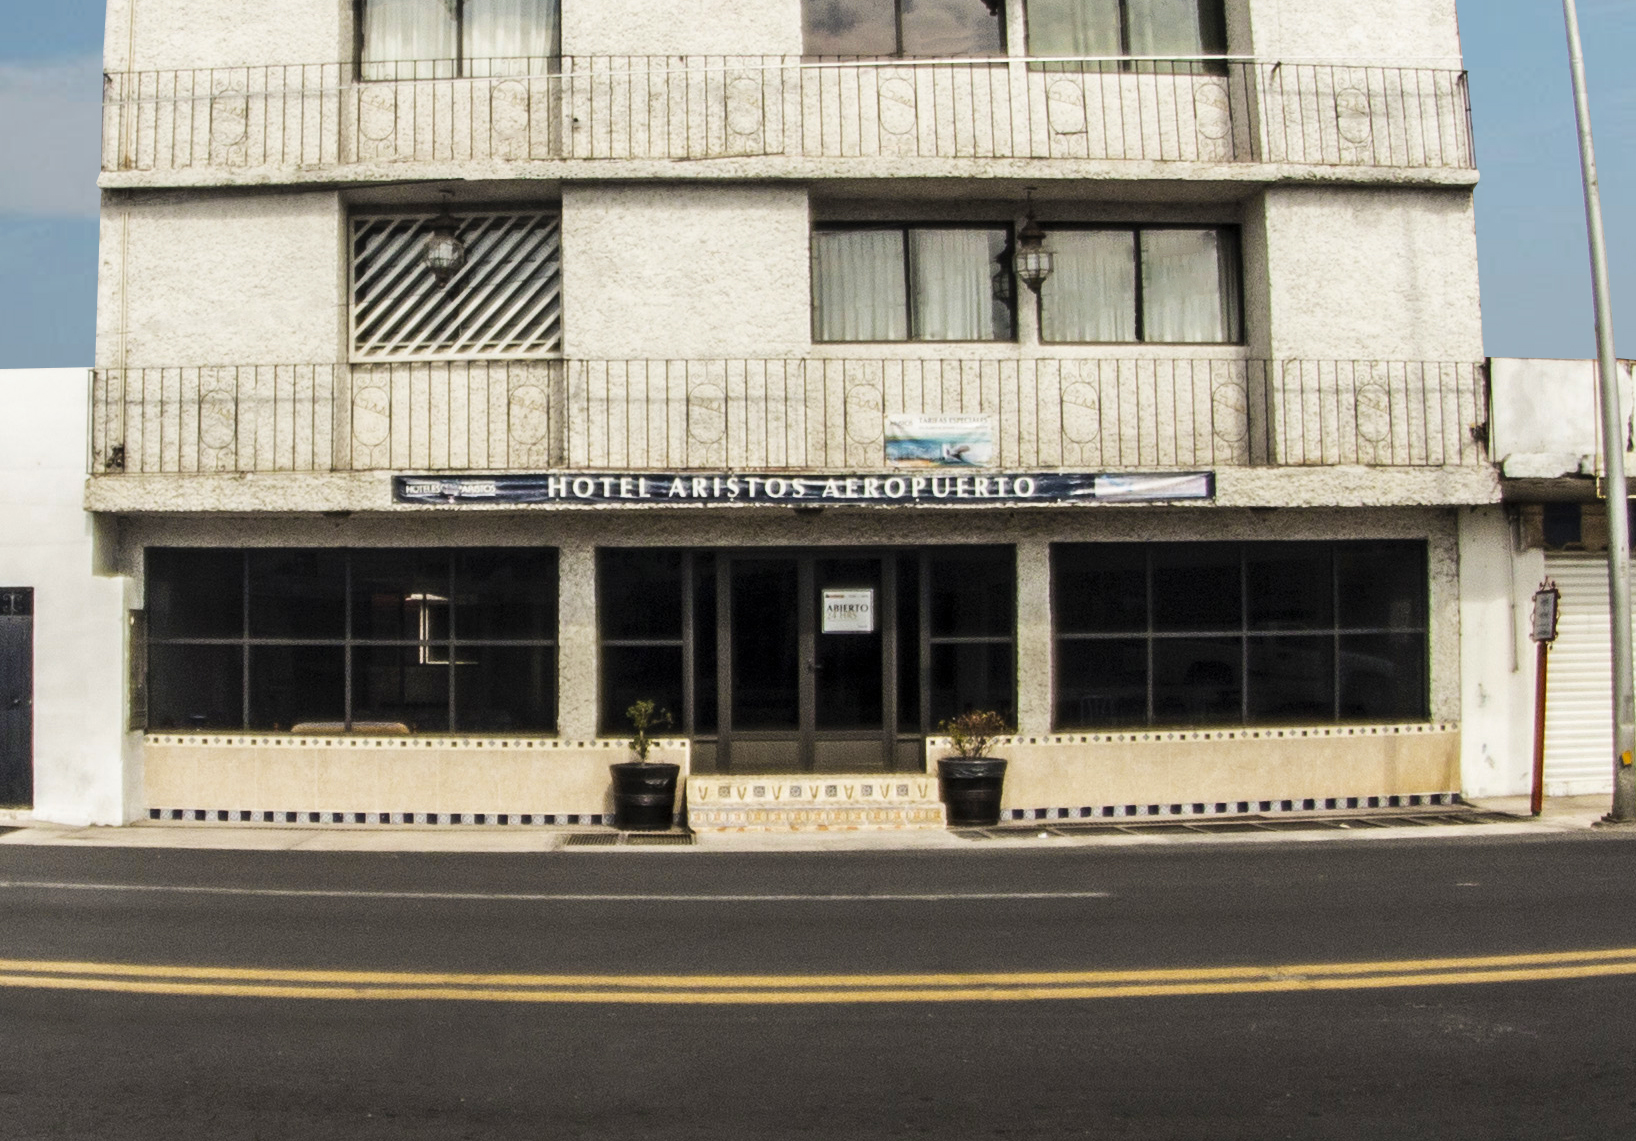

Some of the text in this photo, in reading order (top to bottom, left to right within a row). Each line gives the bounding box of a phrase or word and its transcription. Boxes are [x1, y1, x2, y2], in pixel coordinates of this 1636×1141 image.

[919, 416, 947, 424] TARIFAS
[948, 416, 988, 424] ESPECIALES
[405, 484, 440, 495] HOTELES
[547, 476, 1036, 498] HOTEL ARISTOS AEROPUERTO
[827, 603, 869, 613] ABIERTO
